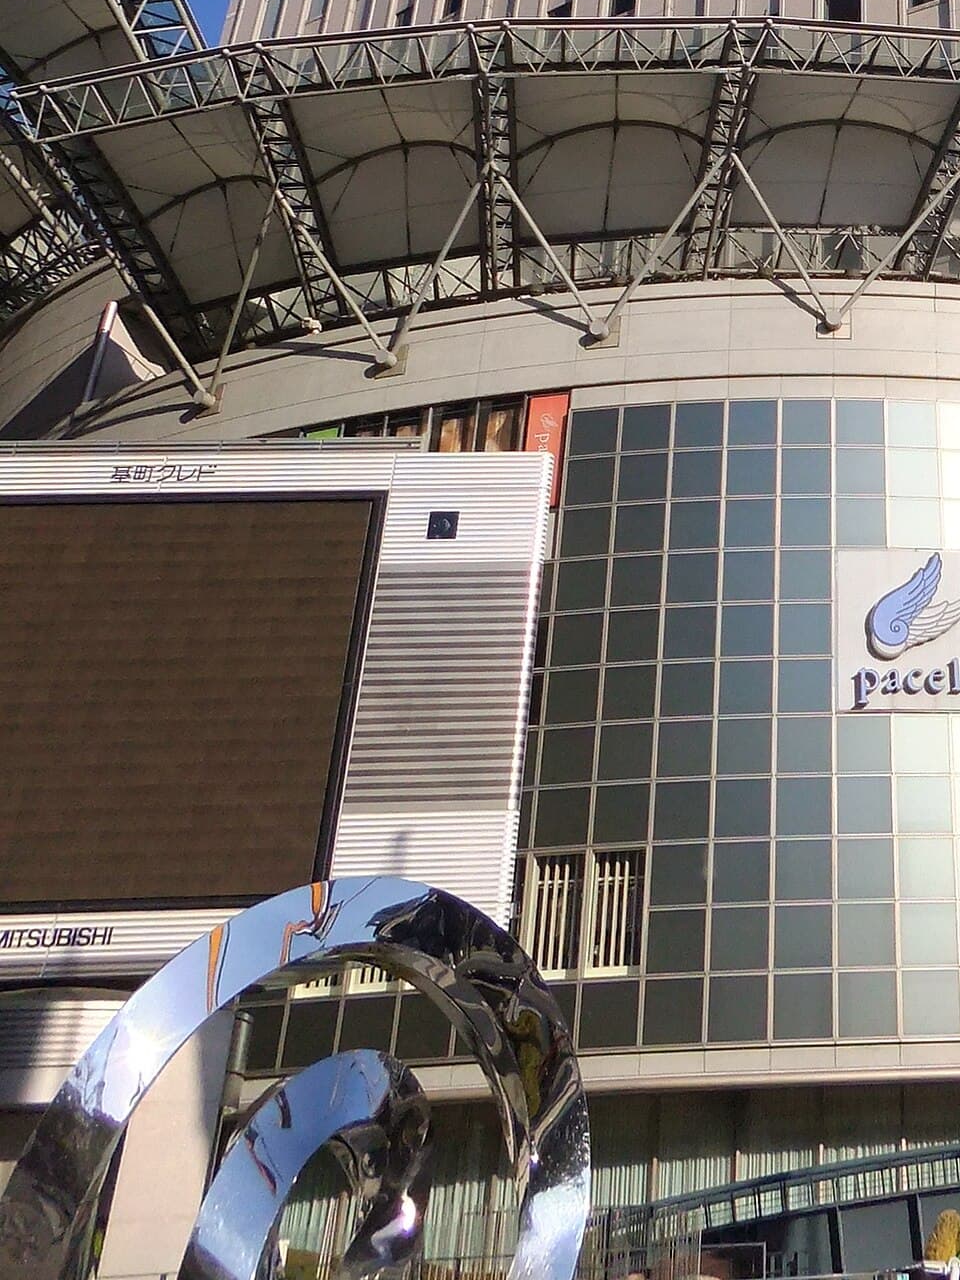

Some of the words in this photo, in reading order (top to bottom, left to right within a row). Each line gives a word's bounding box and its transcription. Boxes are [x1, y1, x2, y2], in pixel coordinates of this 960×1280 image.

[110, 464, 217, 483] 基町クレド
